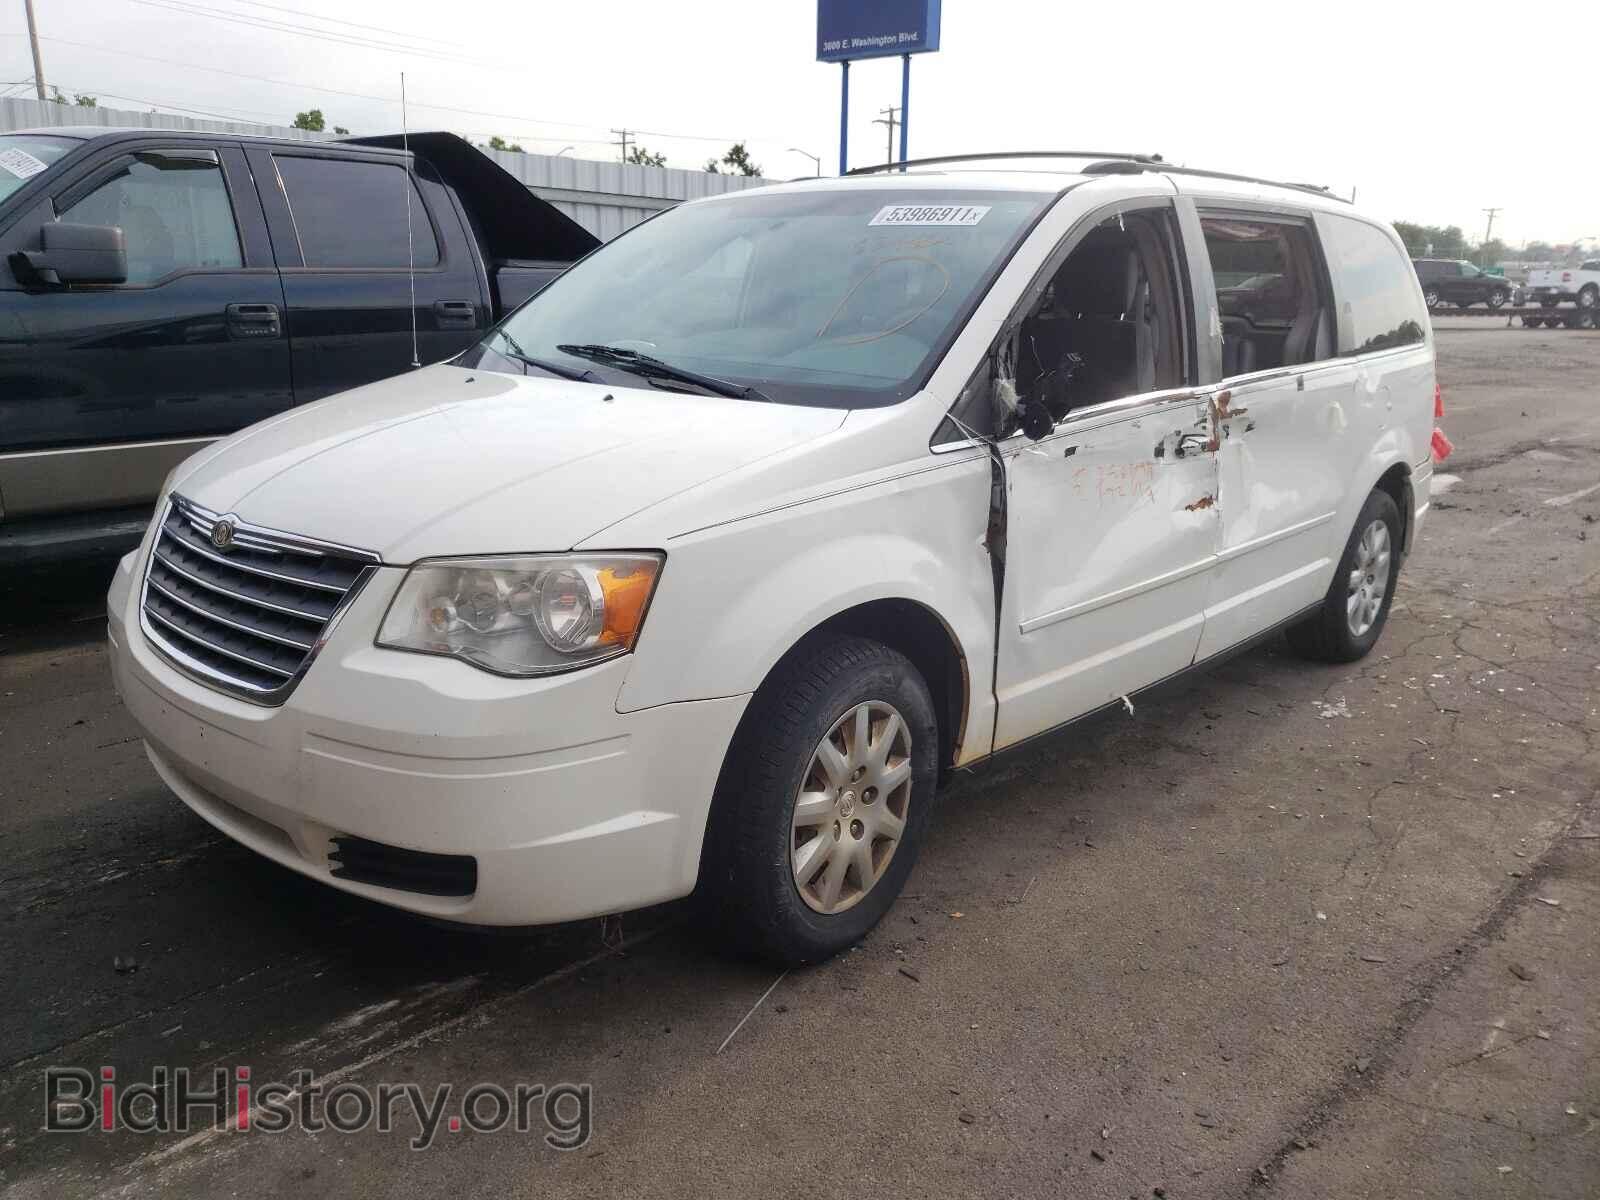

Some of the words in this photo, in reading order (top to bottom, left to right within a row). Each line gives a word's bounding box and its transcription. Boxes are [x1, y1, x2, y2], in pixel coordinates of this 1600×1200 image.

[842, 39, 850, 49] E.
[851, 35, 897, 48] Washington
[898, 32, 919, 43] Blvd.
